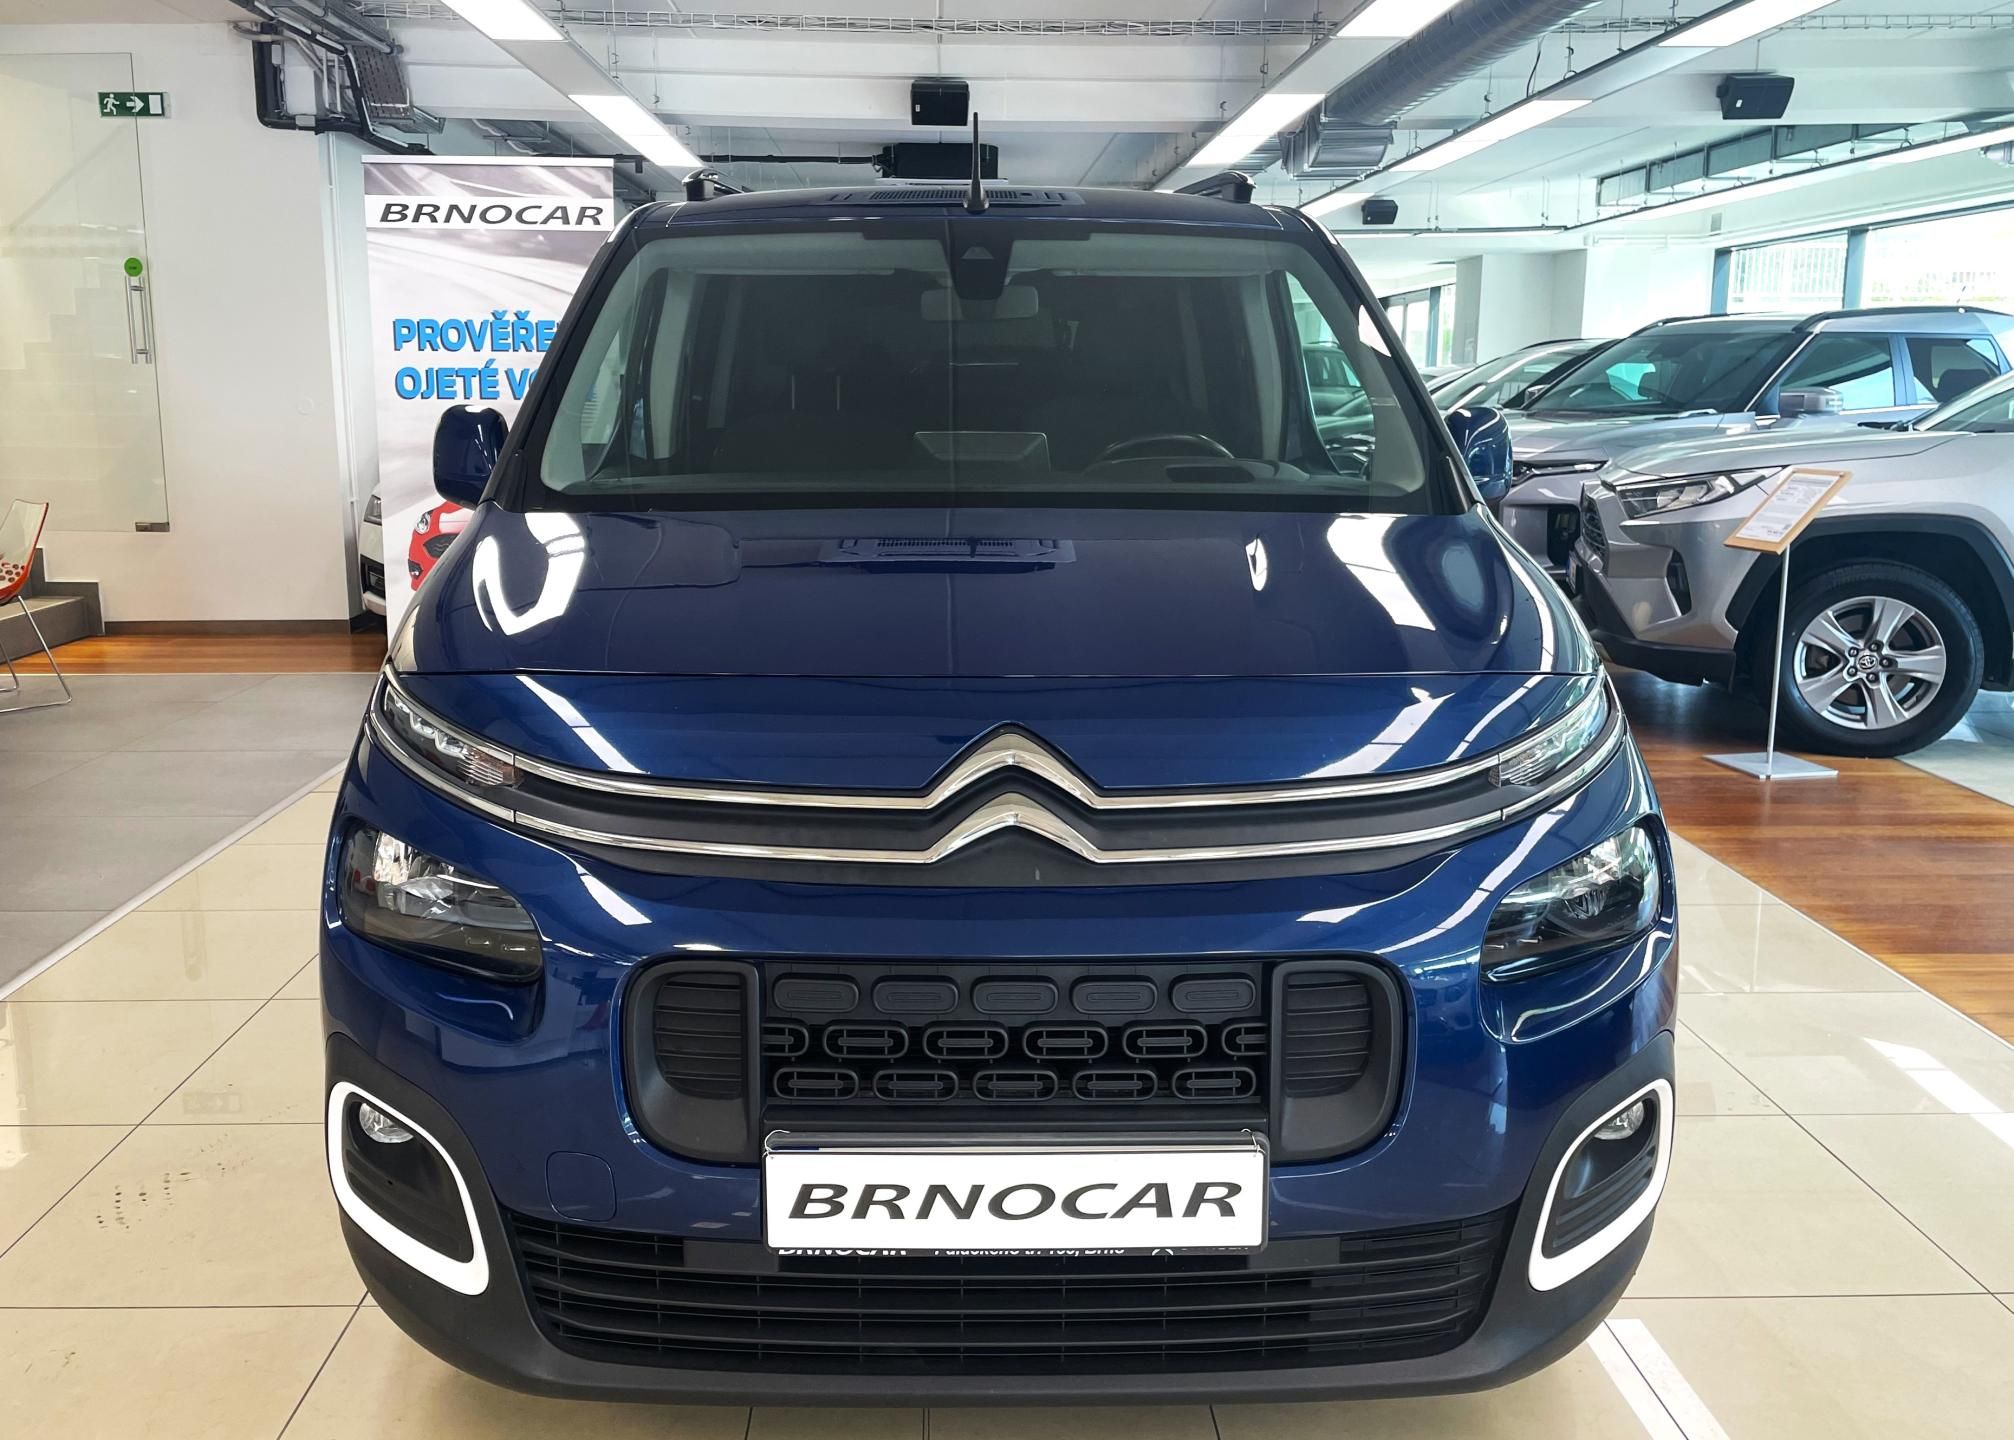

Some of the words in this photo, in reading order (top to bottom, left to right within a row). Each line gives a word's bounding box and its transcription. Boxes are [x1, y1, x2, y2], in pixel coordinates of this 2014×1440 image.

[379, 202, 603, 226] BRNOCAR
[392, 310, 560, 352] PROVĚŘE
[394, 358, 500, 400] OJETÉ
[505, 367, 539, 400] V
[787, 1181, 1242, 1221] BRNOCAR
